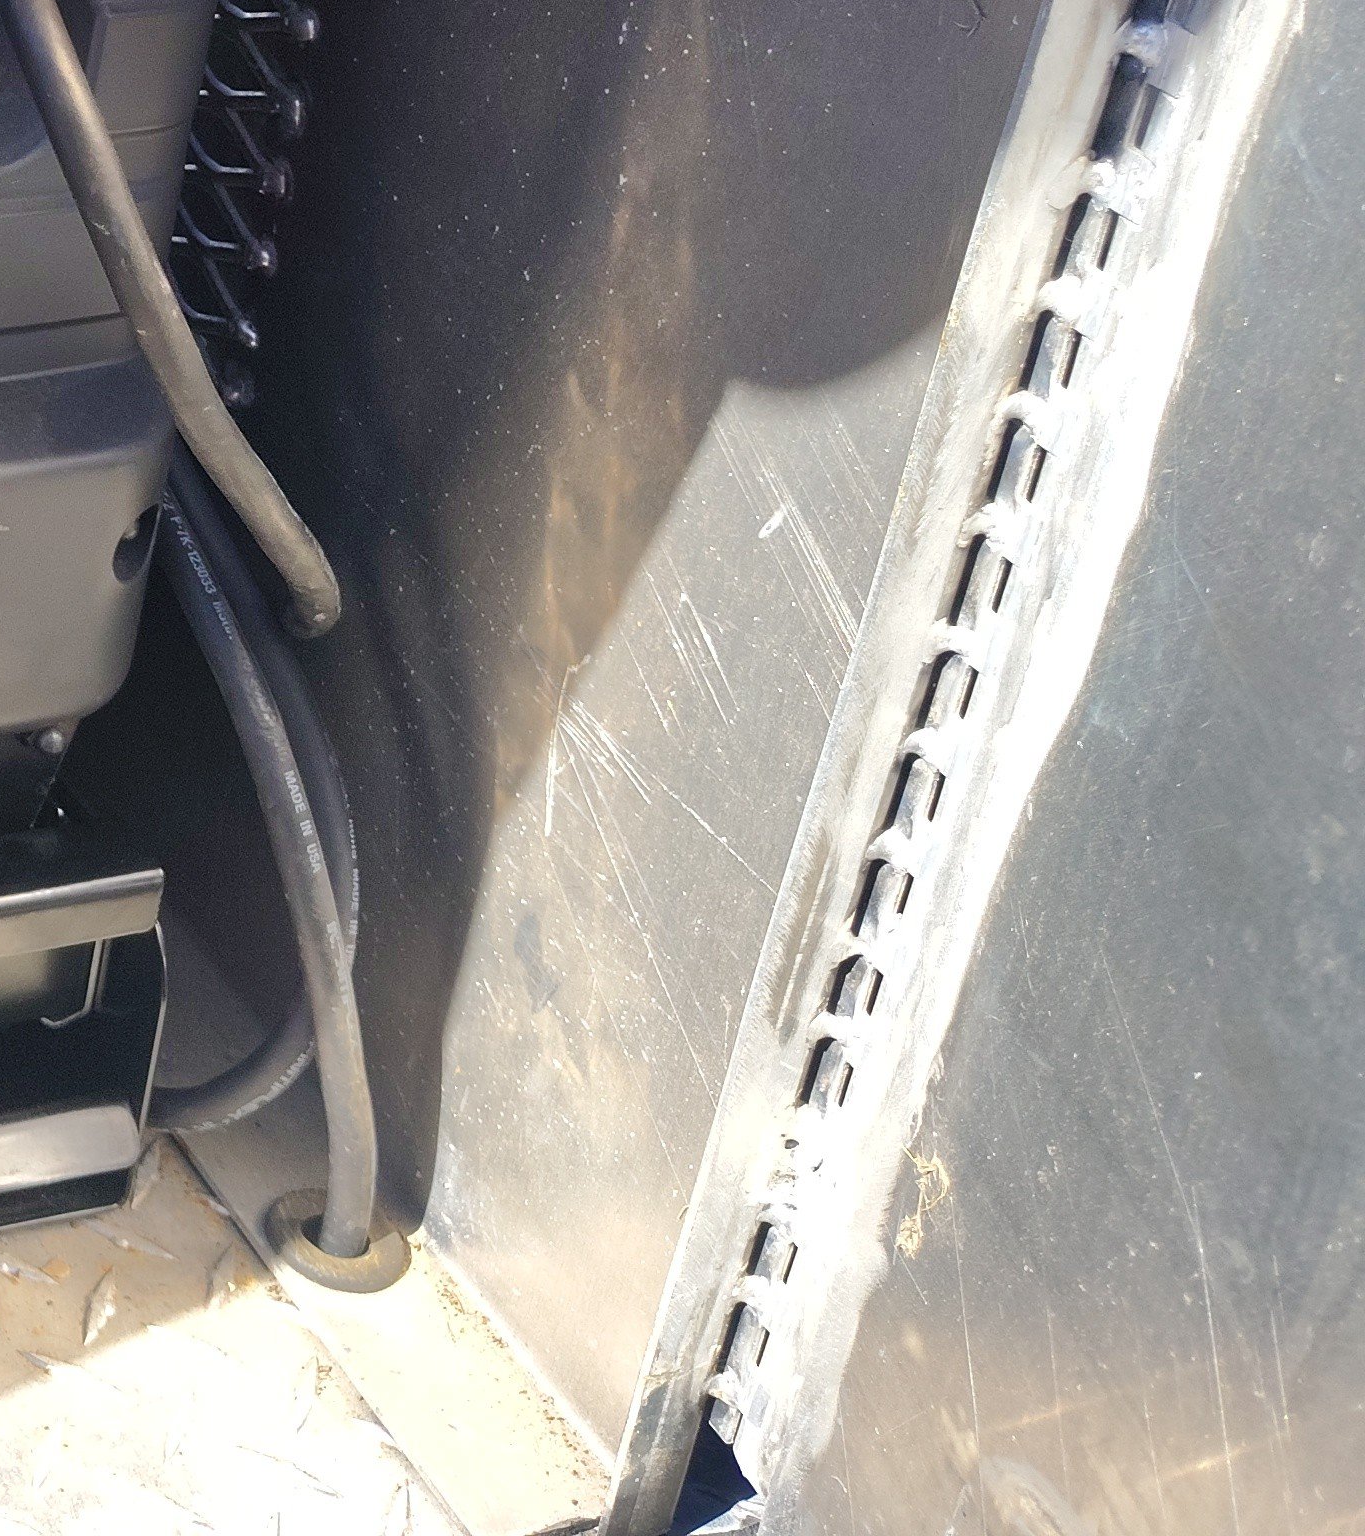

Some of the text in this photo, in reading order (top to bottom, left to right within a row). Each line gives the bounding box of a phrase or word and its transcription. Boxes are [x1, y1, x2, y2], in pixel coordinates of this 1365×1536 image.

[282, 770, 322, 875] MADE IN USA
